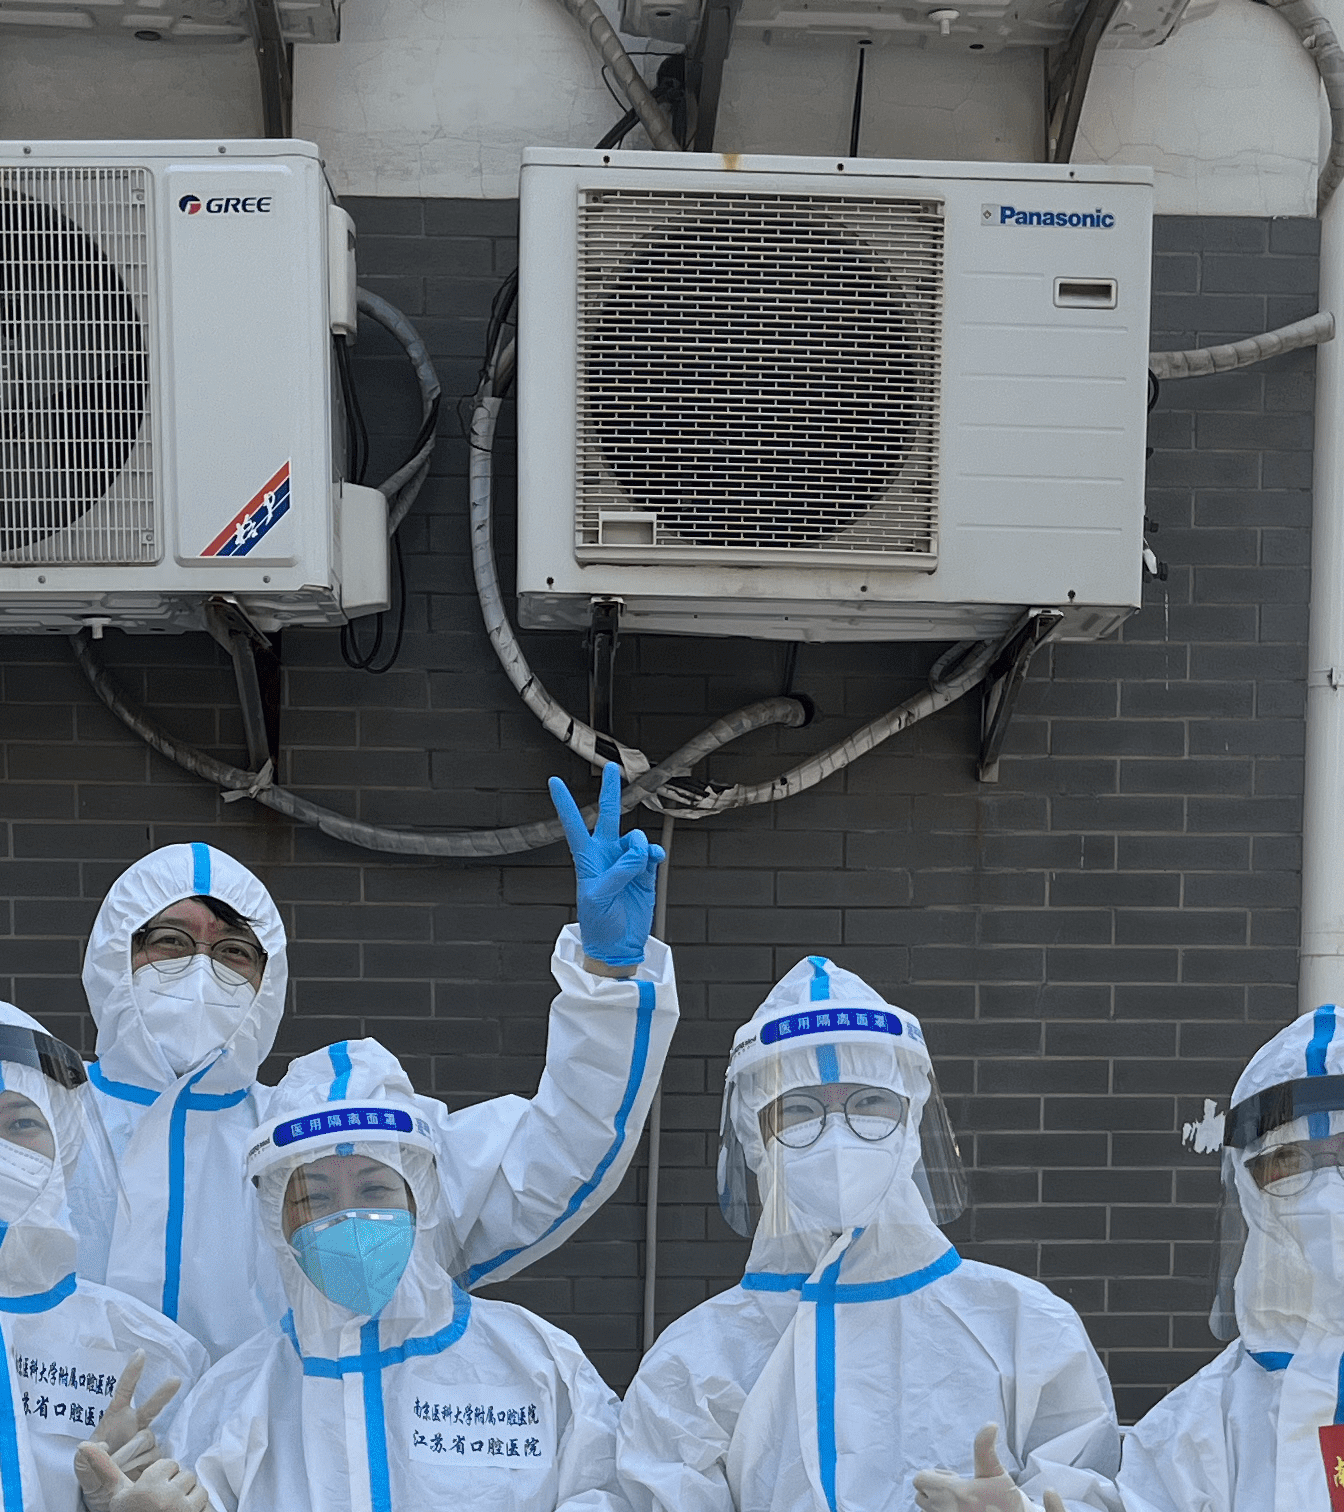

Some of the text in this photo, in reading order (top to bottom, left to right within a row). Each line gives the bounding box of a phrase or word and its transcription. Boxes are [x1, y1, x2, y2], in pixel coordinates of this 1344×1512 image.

[205, 196, 272, 214] GREE
[999, 205, 1115, 228] Panasonic
[778, 1011, 889, 1036] 医用隔离面罩
[290, 1111, 398, 1138] 医用隔离面罩
[15, 1353, 117, 1398] 京医科大学附属口腔医院
[413, 1396, 539, 1427] 南京医科大学附属口腔医院
[412, 1429, 542, 1458] 江苏省口腔医院
